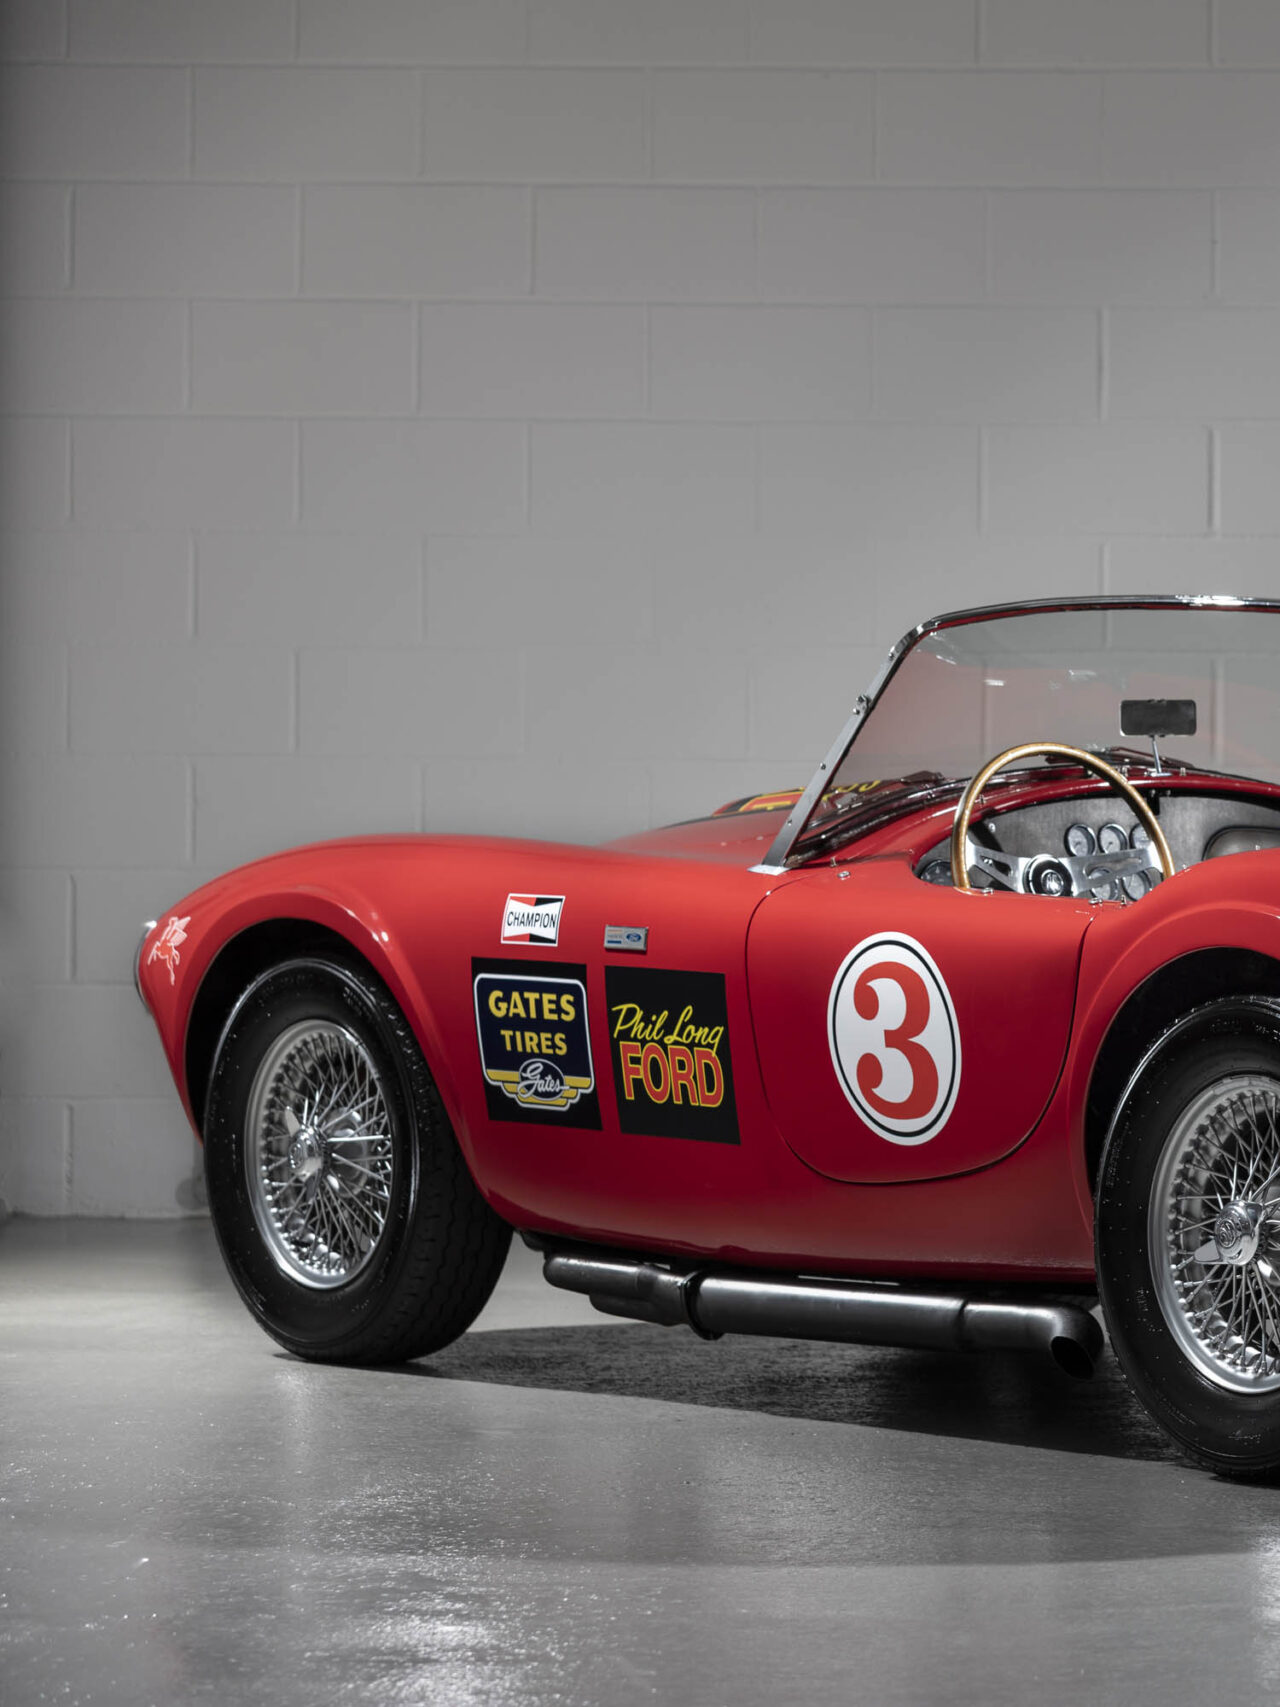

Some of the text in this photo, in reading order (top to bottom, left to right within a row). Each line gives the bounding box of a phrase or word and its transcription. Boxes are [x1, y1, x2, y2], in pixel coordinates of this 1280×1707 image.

[506, 910, 556, 928] CHAMPION
[488, 990, 576, 1022] GATES
[500, 1030, 568, 1056] TIRES
[611, 1003, 724, 1057] Phil Long
[853, 961, 939, 1120] 3
[517, 1062, 570, 1097] Gates
[619, 1041, 724, 1108] FORD
